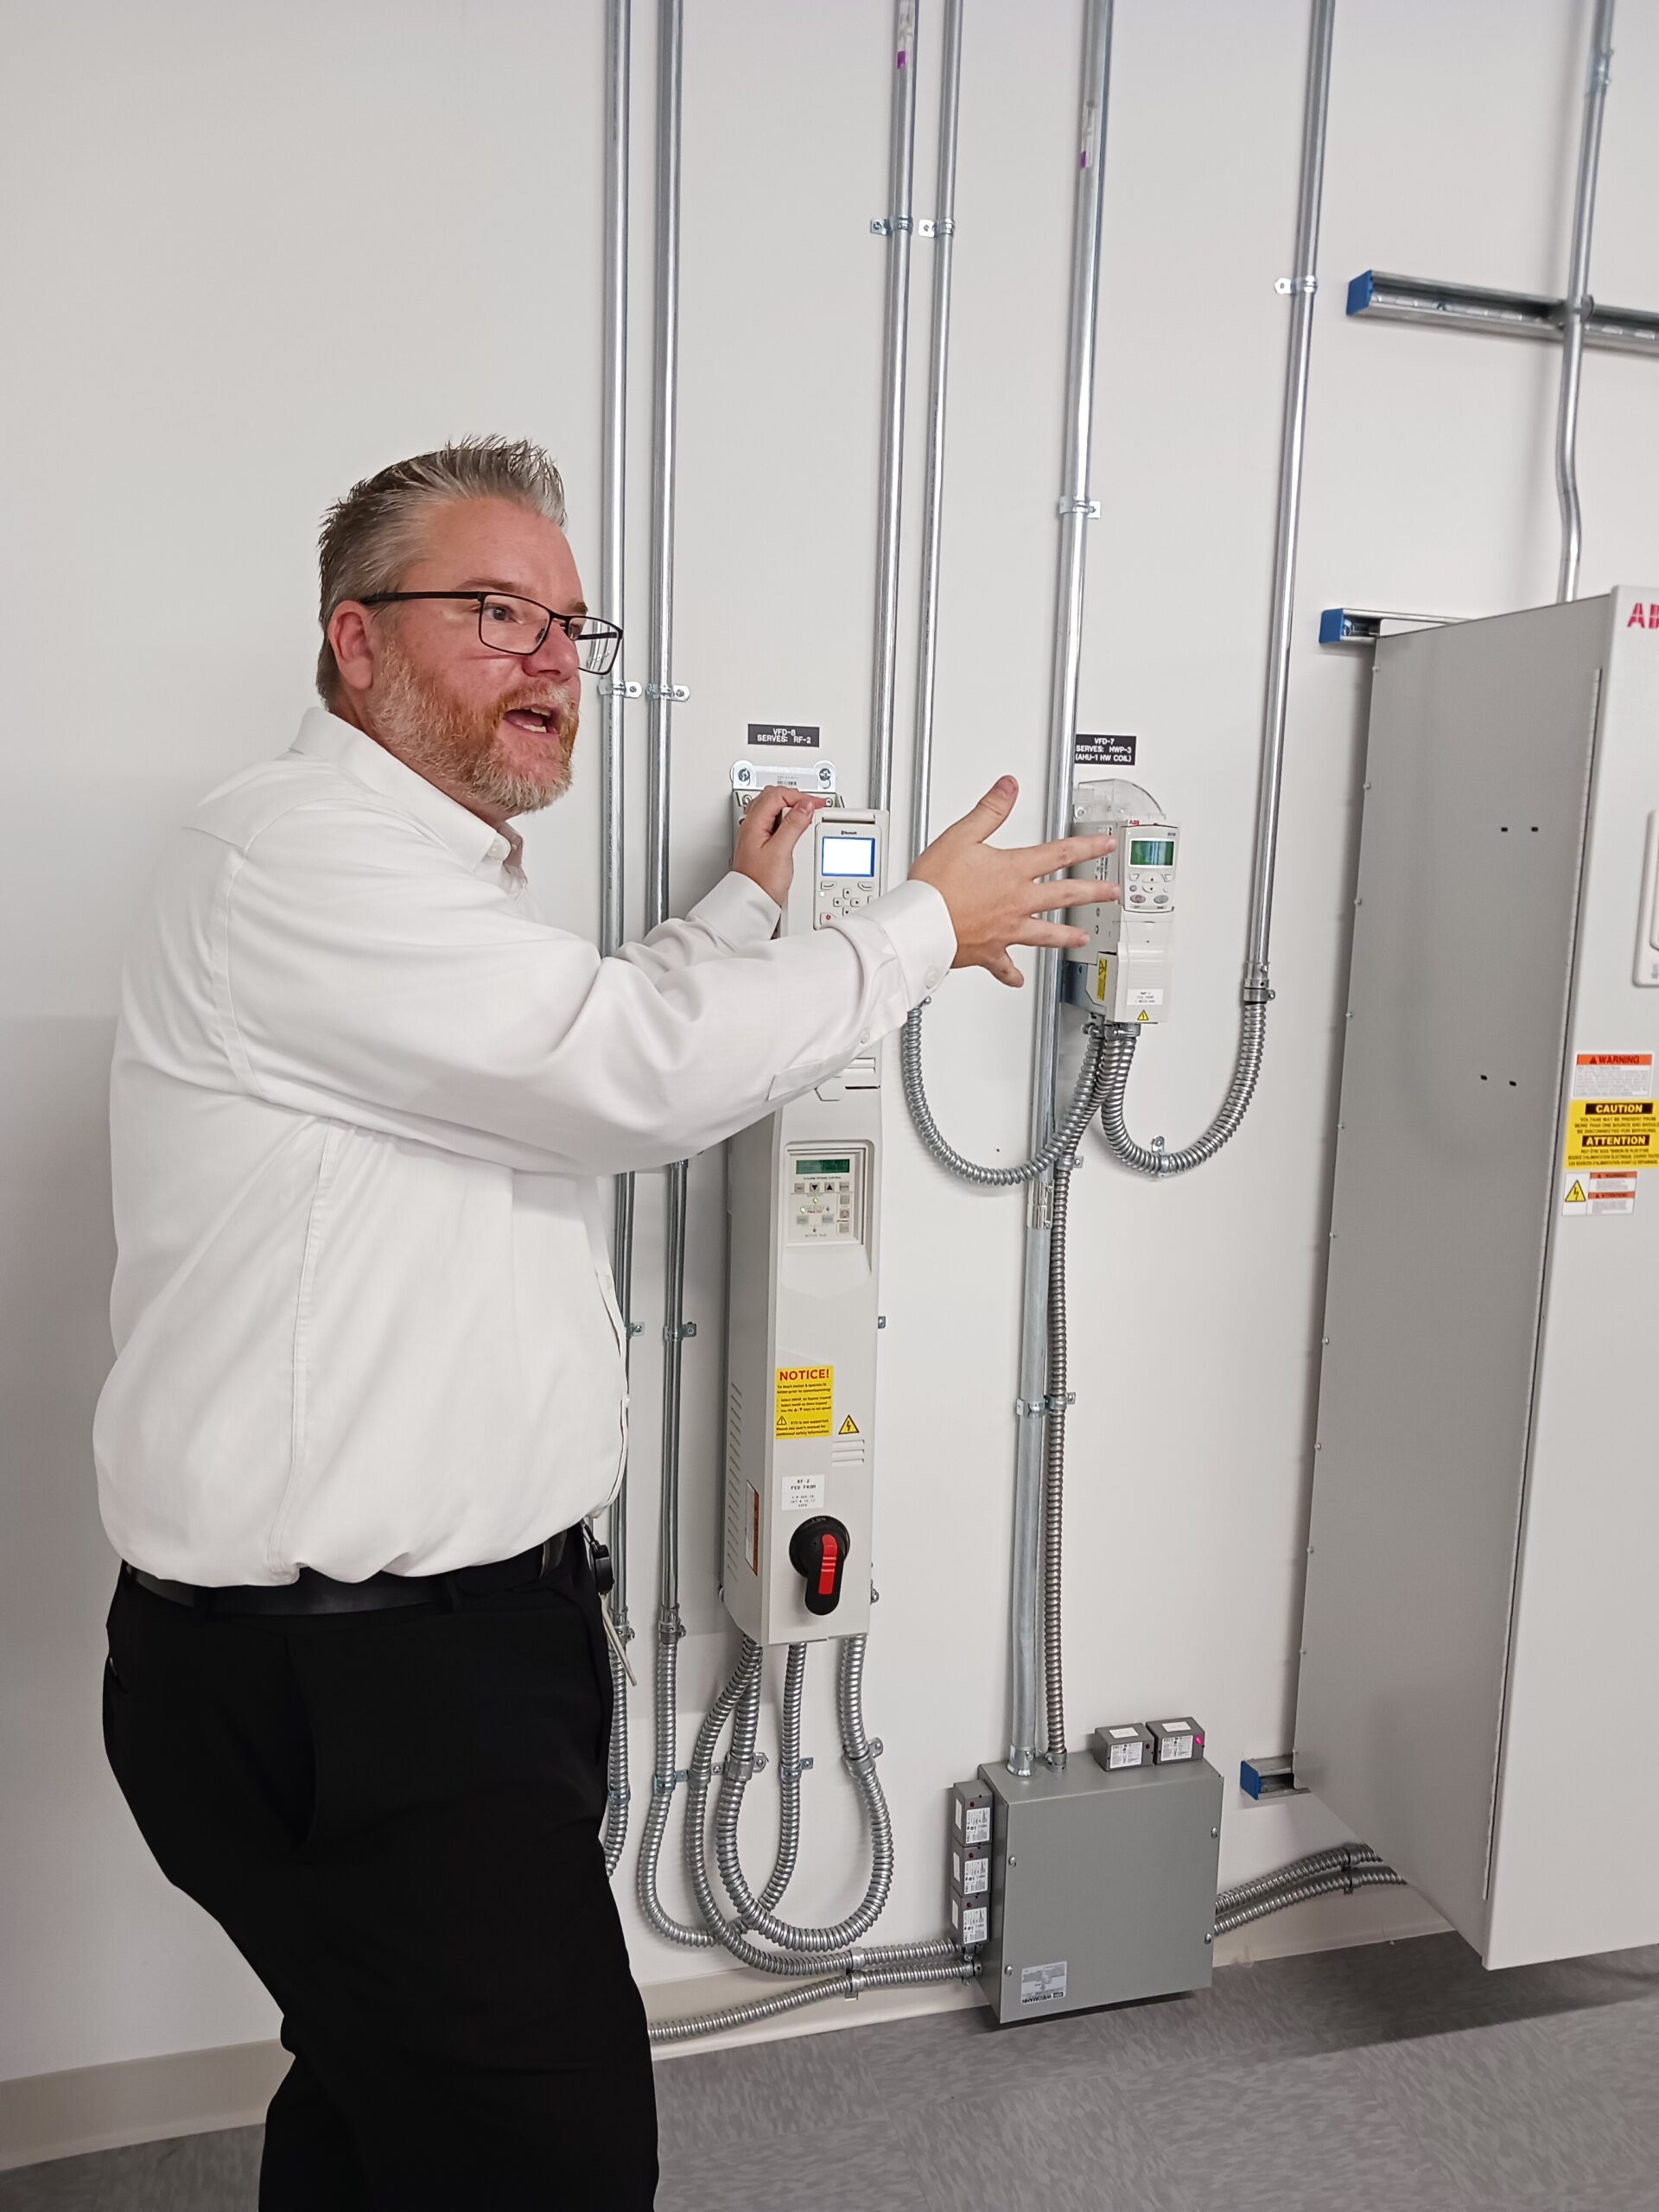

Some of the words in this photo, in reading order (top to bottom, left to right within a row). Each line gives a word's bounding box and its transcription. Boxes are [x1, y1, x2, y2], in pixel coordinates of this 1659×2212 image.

[773, 728, 796, 736] VFD-8
[1599, 1055, 1639, 1064] WARNING
[1596, 1104, 1643, 1113] CAUTION
[1586, 1136, 1645, 1145] ATTENTION
[780, 1369, 829, 1381] NOTICE!
